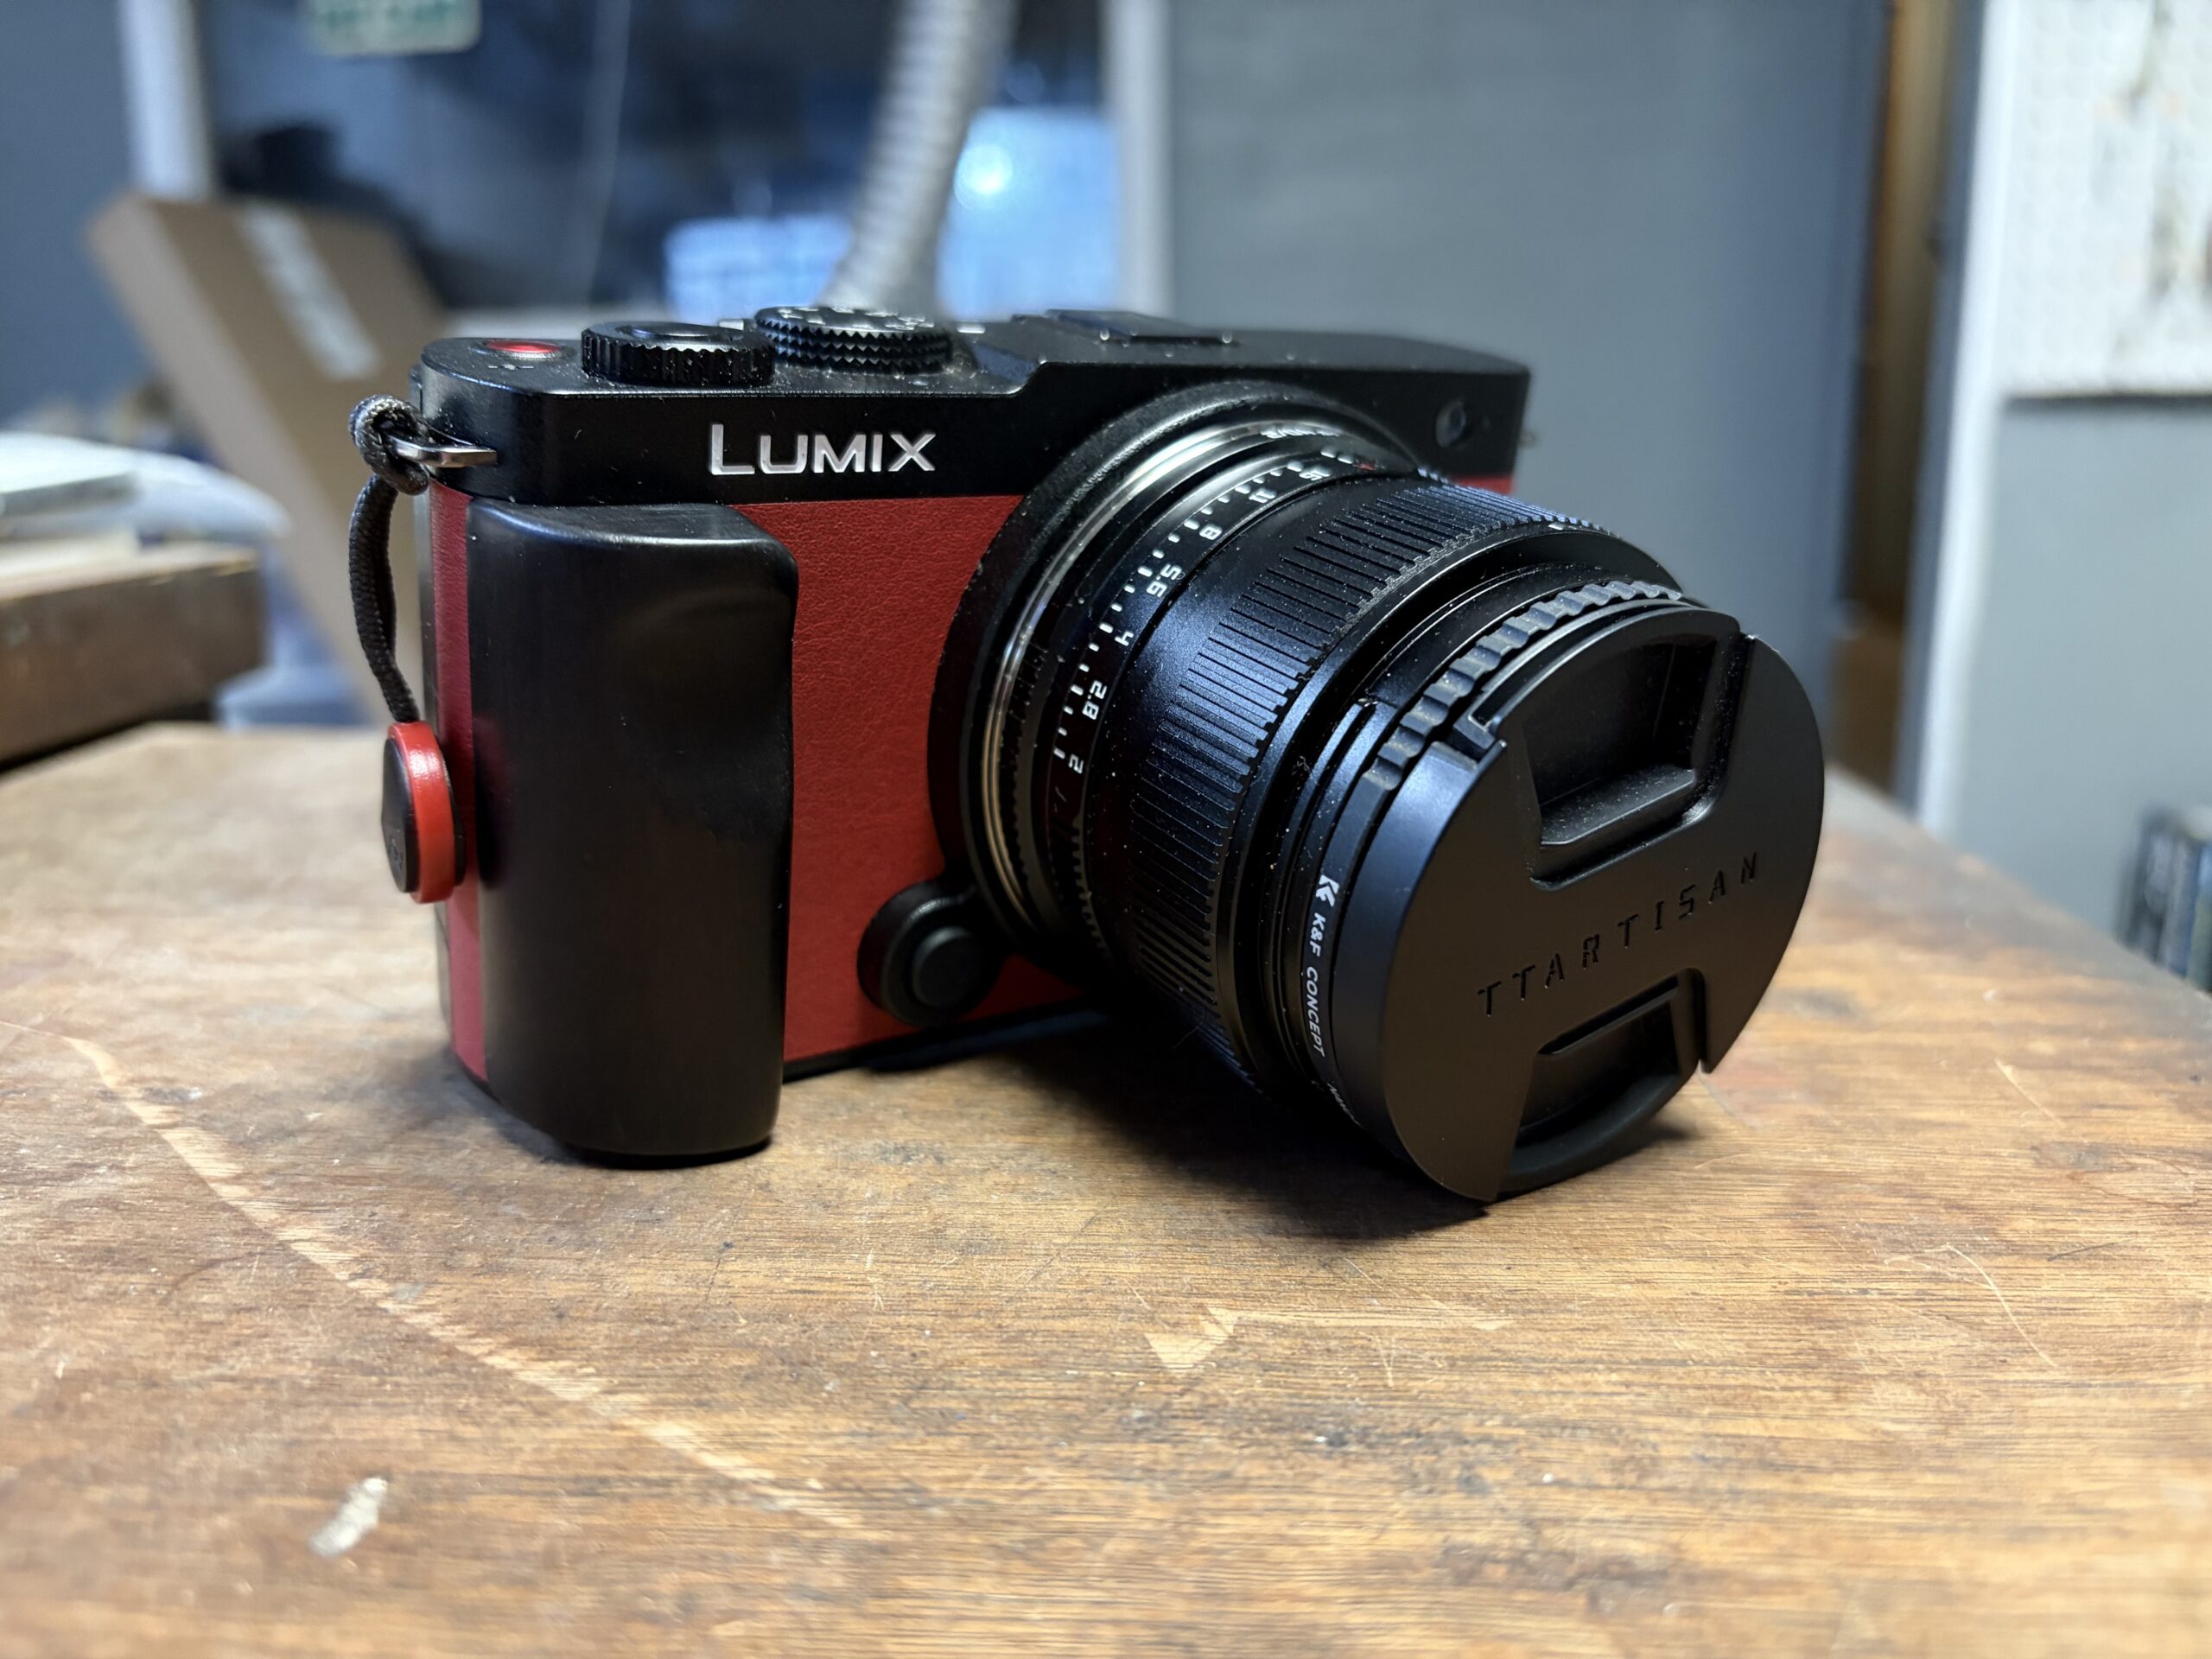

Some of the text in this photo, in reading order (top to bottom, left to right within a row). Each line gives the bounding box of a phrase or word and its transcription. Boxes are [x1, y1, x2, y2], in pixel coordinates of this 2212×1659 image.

[709, 423, 936, 476] LUMIX
[1068, 464, 1332, 774] 16 11 8 5.6 4 2.8 2
[1306, 912, 1326, 1058] K&F CONCEPT
[1478, 851, 1758, 1018] TTARTISAN
